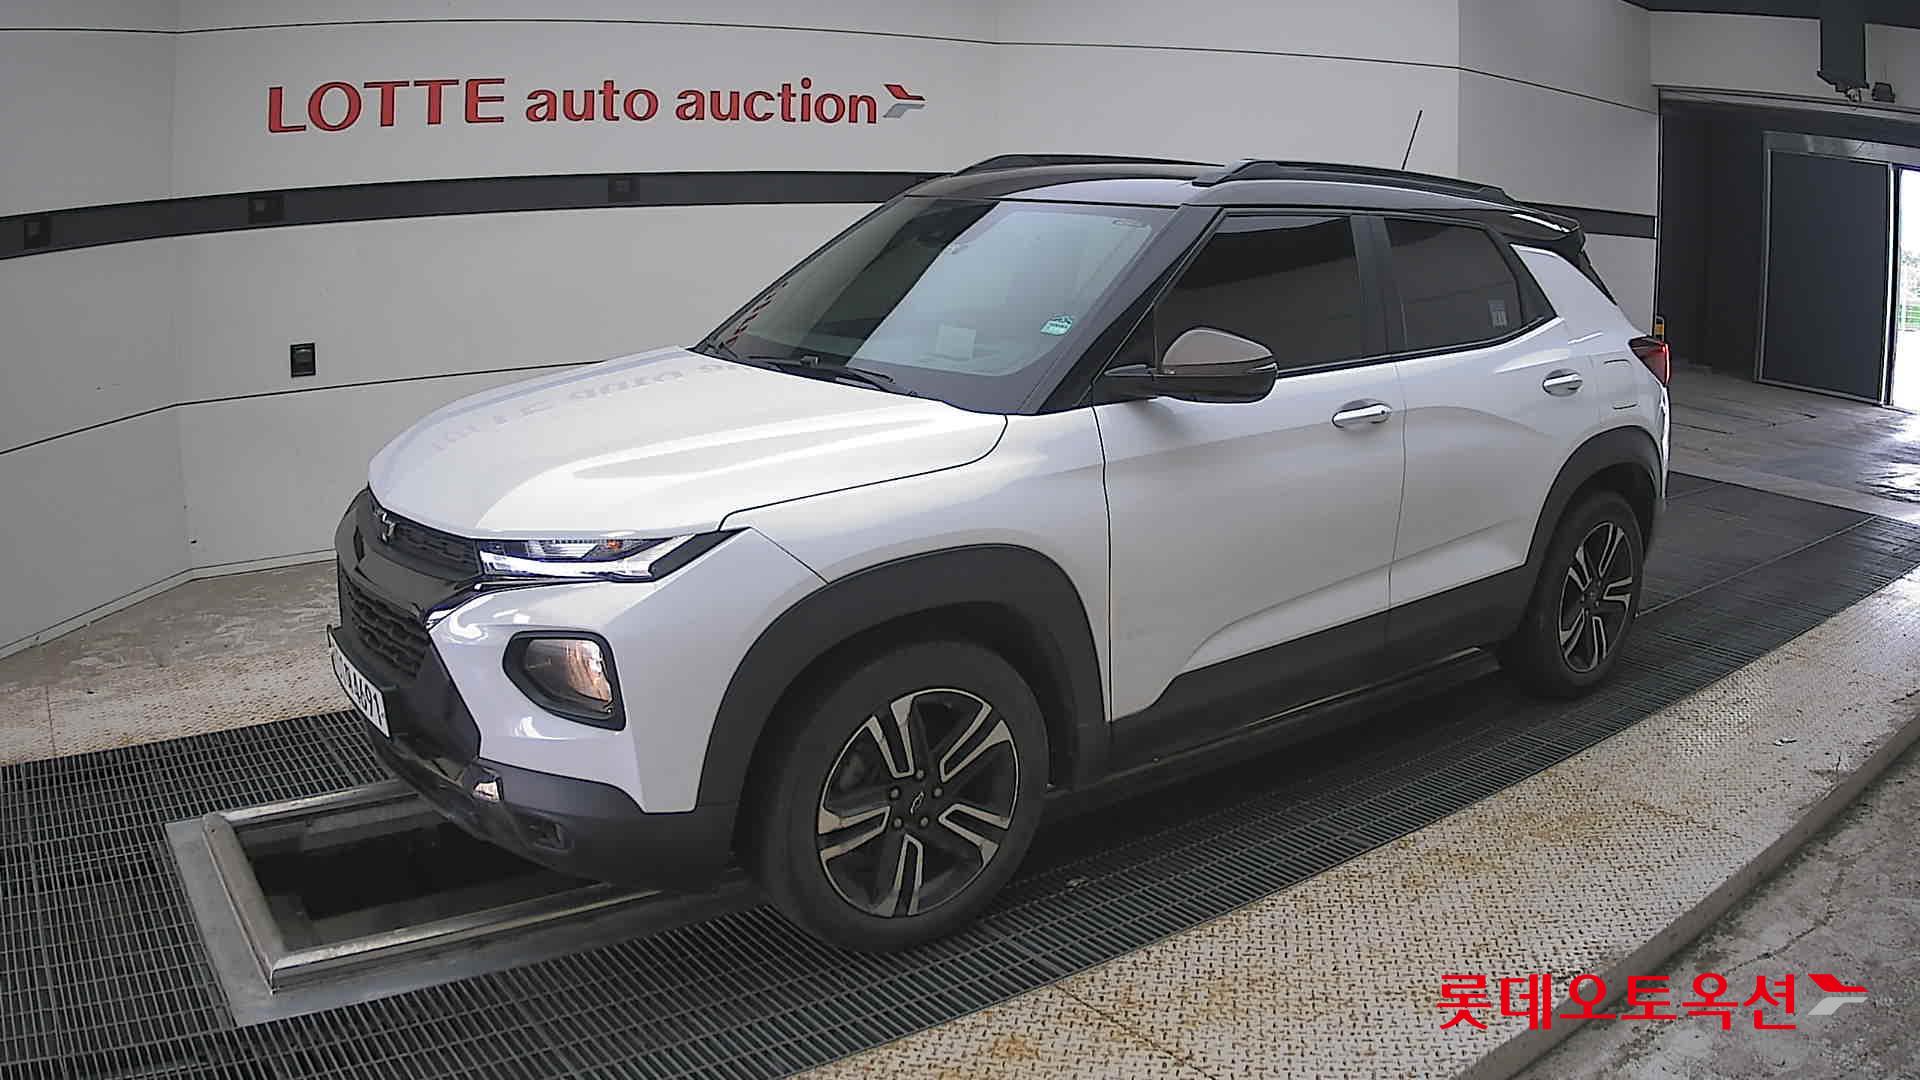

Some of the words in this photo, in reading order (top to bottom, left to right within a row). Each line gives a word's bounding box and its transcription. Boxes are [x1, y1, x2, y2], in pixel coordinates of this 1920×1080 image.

[267, 78, 506, 134] LOTTE
[525, 80, 660, 123] auto
[675, 77, 879, 124] auction
